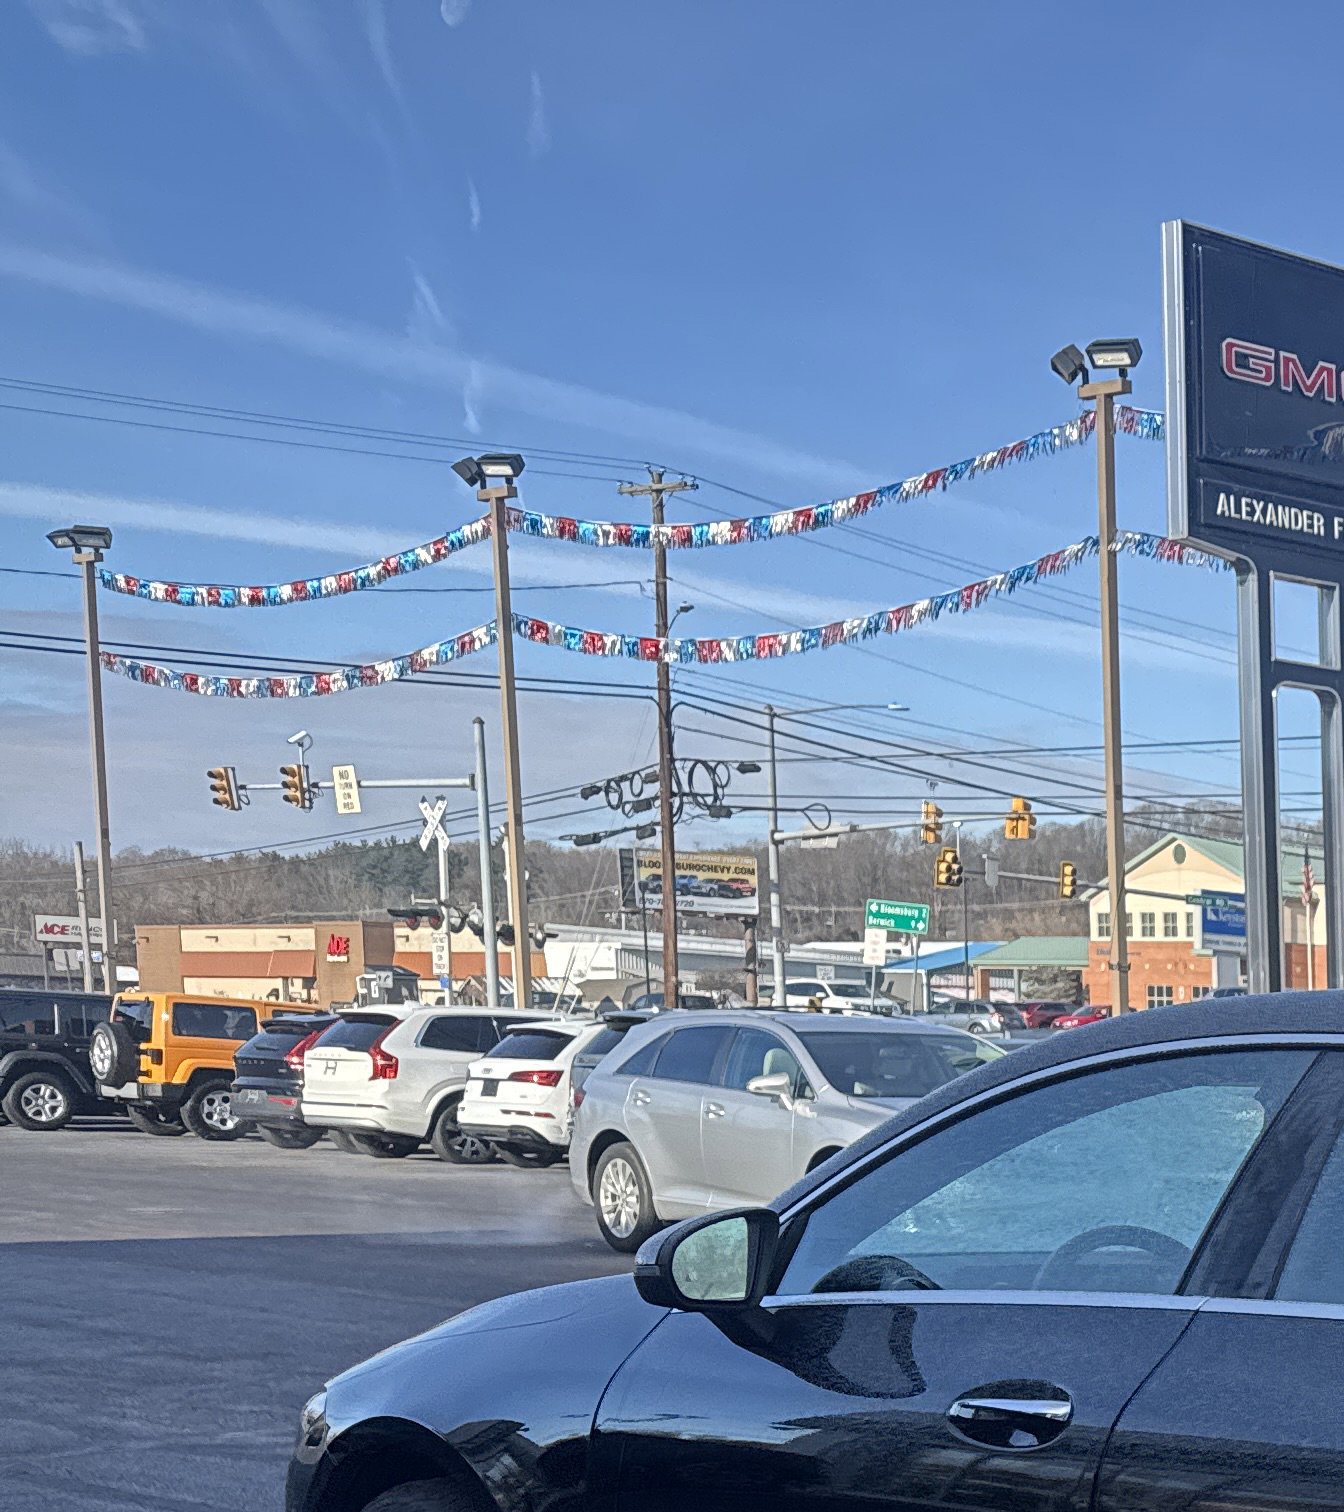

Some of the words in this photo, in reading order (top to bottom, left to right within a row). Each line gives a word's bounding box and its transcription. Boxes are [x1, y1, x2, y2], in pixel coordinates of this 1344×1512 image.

[1216, 492, 1325, 537] ALEXANDER
[338, 769, 349, 780] NO
[880, 904, 919, 918] Bloomsburg
[39, 921, 71, 936] ACE
[327, 933, 350, 956] ACE
